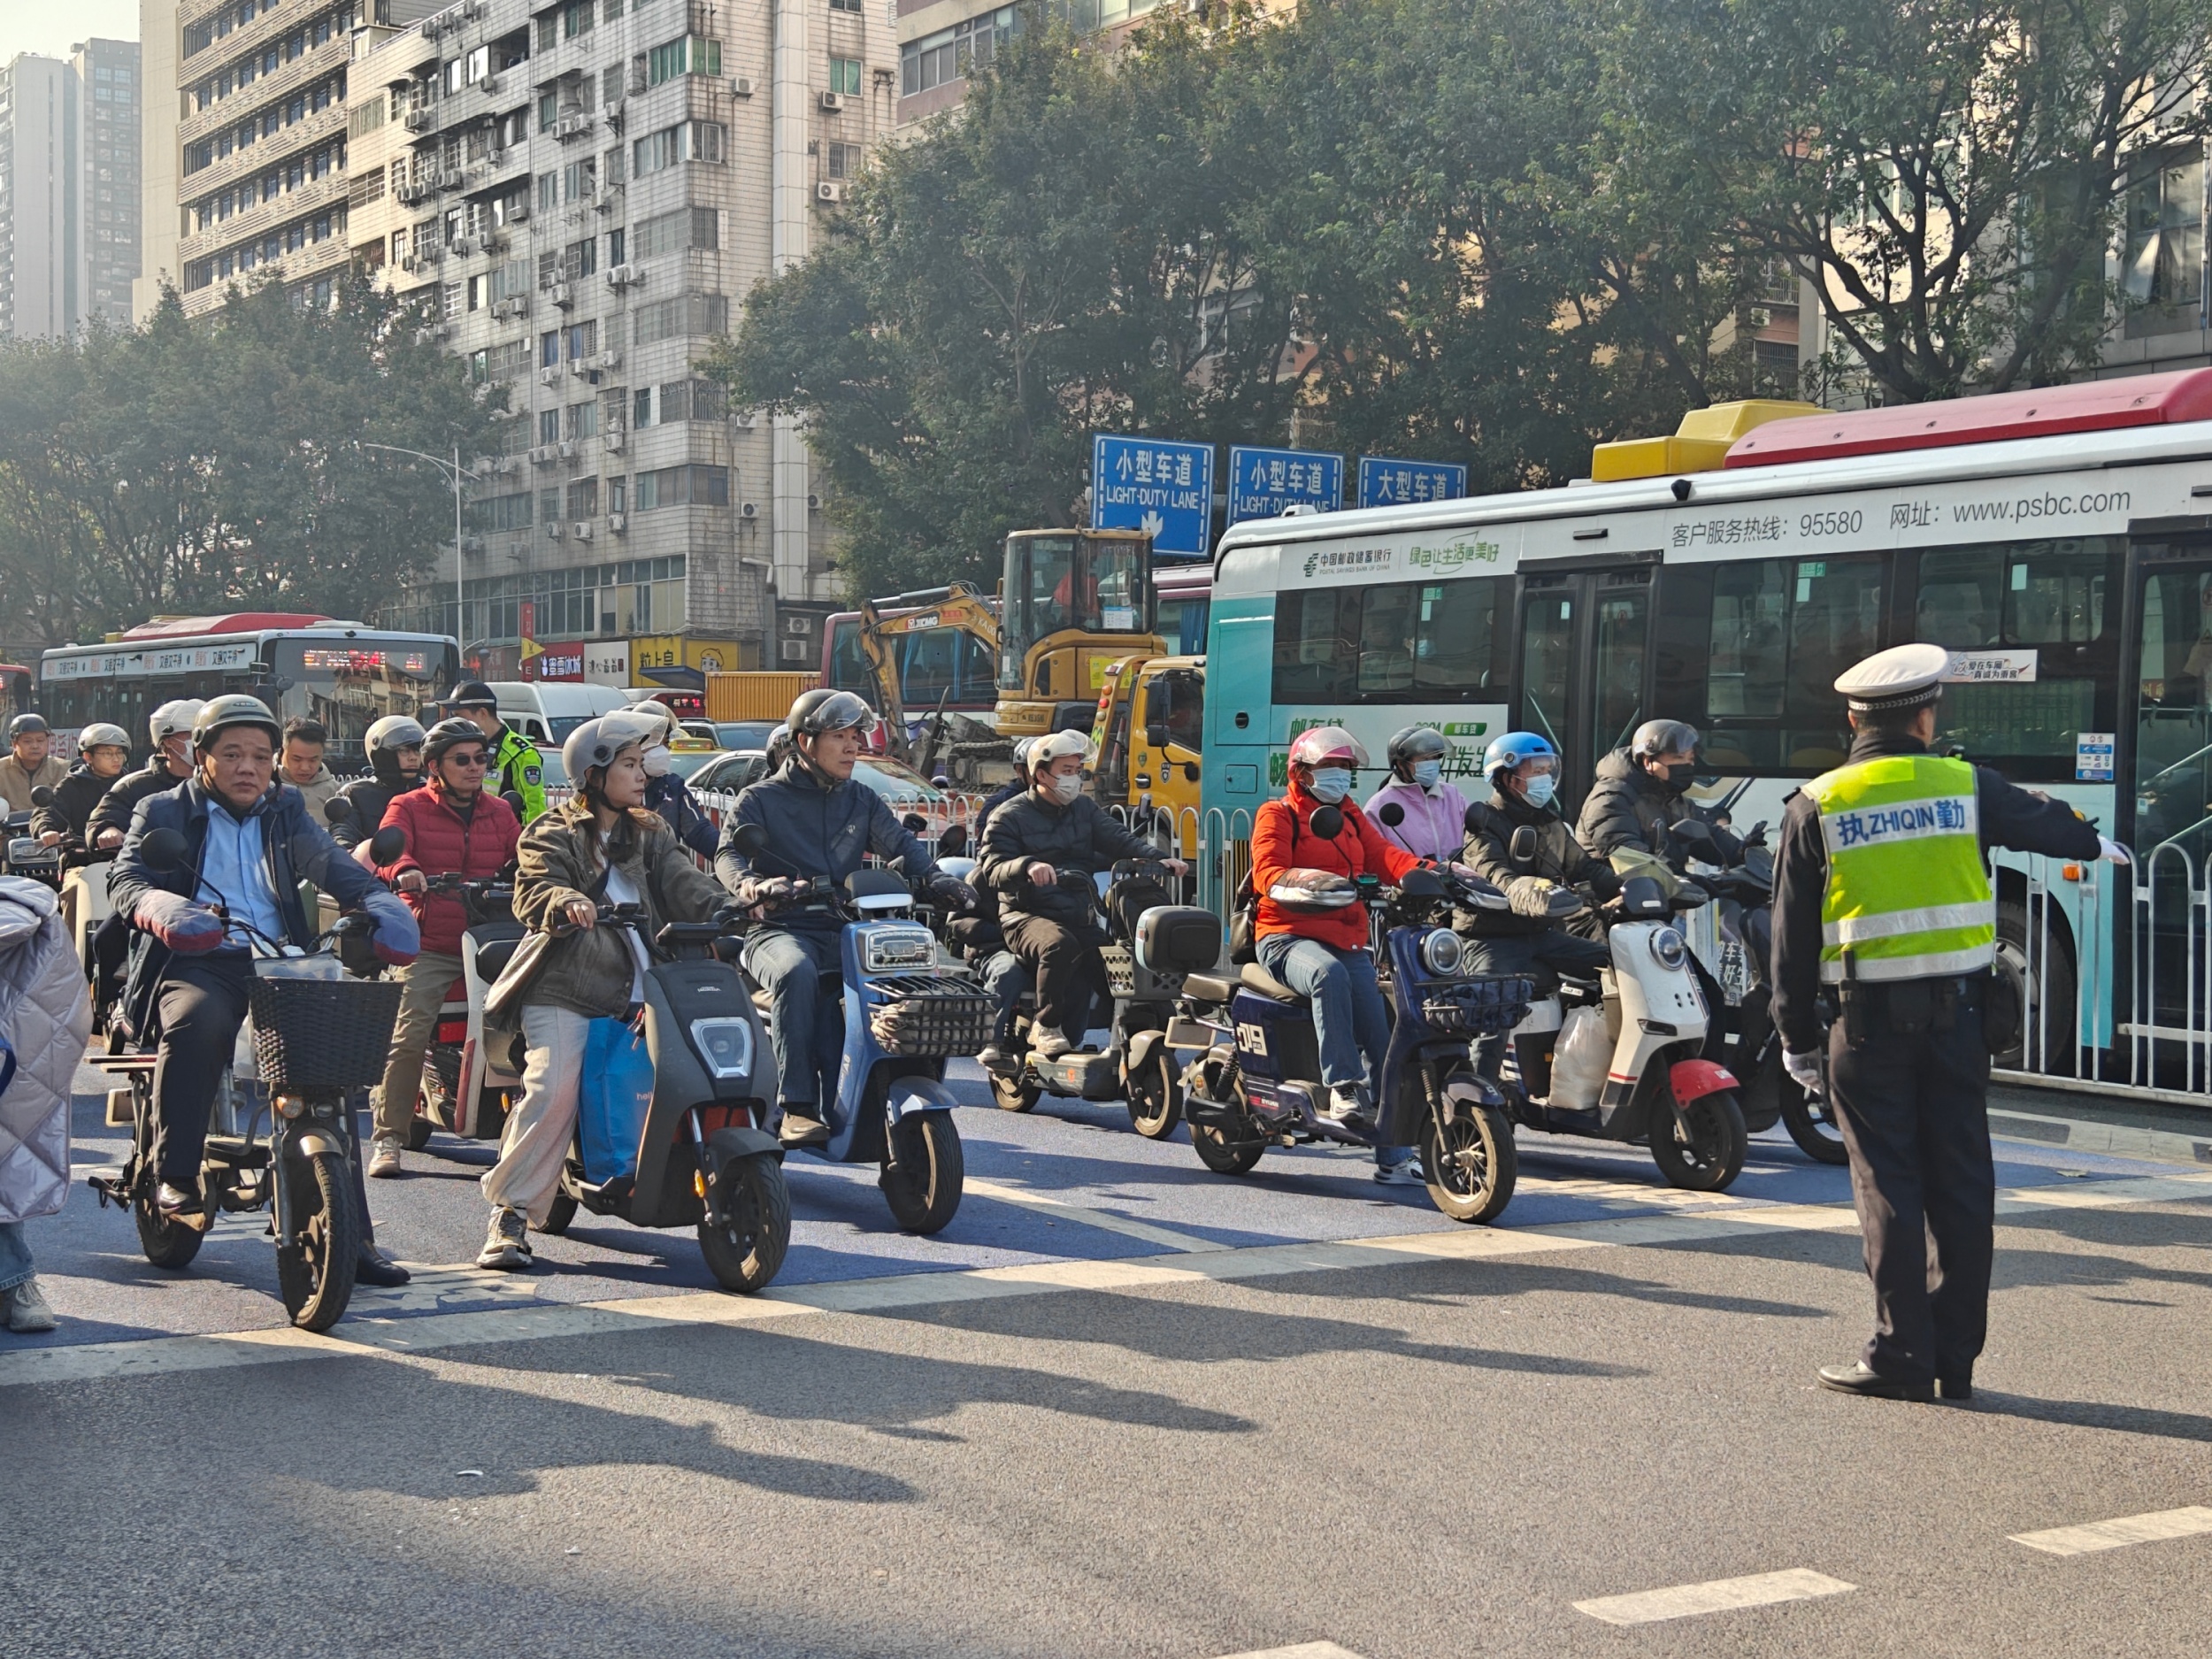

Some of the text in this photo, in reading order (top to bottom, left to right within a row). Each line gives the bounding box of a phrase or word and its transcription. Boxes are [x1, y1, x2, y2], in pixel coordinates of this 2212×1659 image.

[1116, 449, 1192, 486] 小型车道
[1250, 458, 1323, 495] 小型车道
[1106, 485, 1199, 510] LIGHT-DUTY LANE
[1378, 469, 1448, 502] 大型车道
[1800, 510, 1863, 537] 95580
[1953, 491, 2130, 523] www.psbc.com
[1320, 549, 1392, 566] 中国邮政储蓄银行
[1409, 541, 1500, 567] 绿色让生活更美好
[549, 655, 581, 676] 蜜雪冰城
